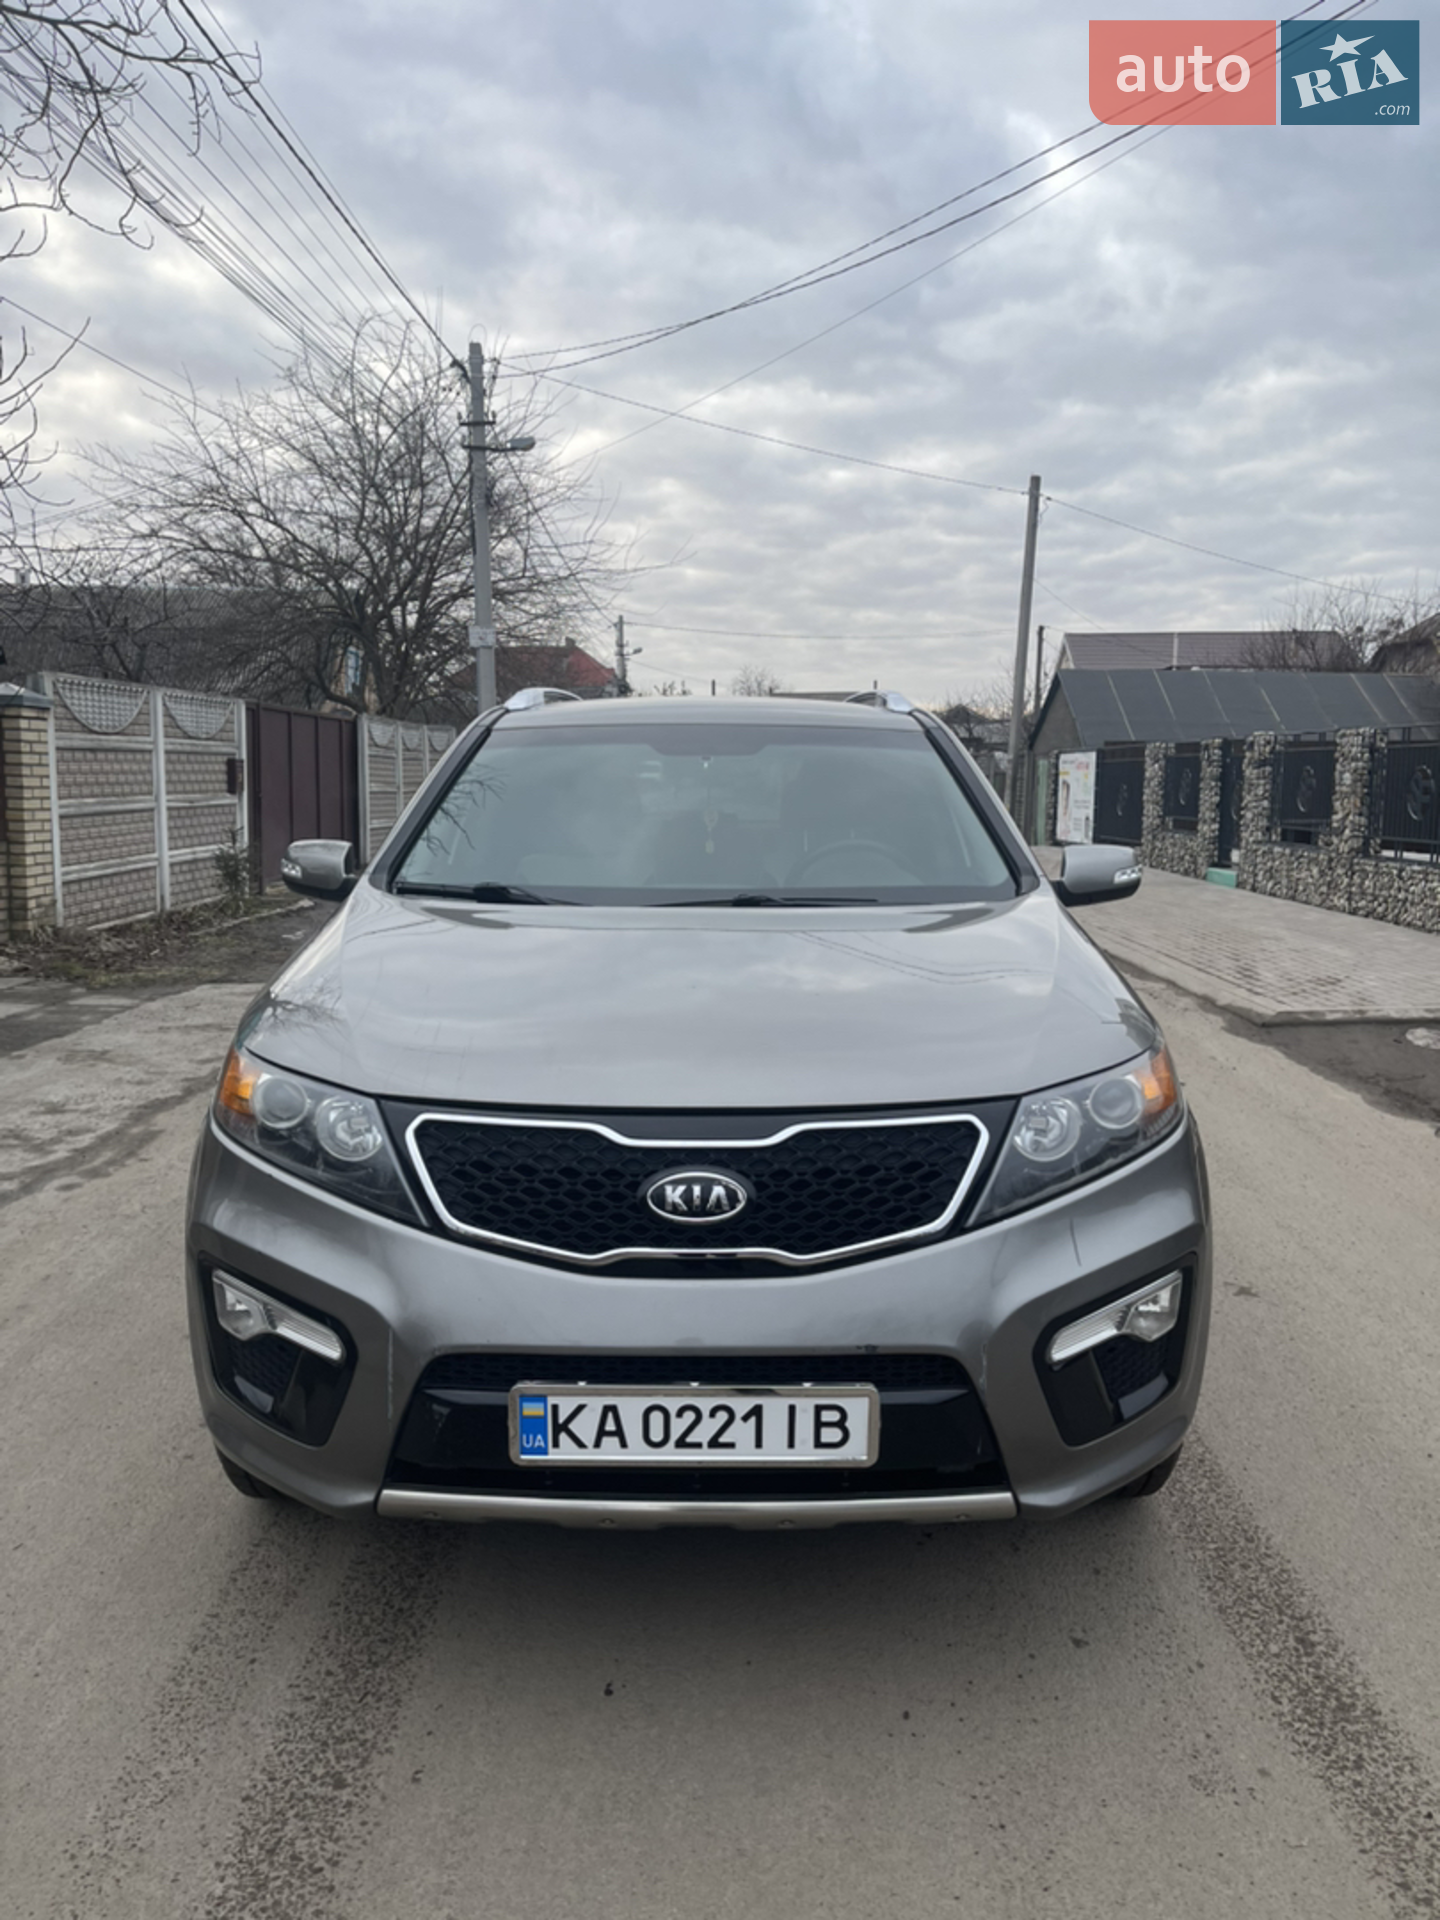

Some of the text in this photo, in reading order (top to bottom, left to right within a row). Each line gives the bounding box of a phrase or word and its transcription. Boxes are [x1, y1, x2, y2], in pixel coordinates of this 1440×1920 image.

[664, 1184, 731, 1212] KIA
[550, 1403, 852, 1450] KA 0221 IB
[522, 1433, 546, 1449] UA
